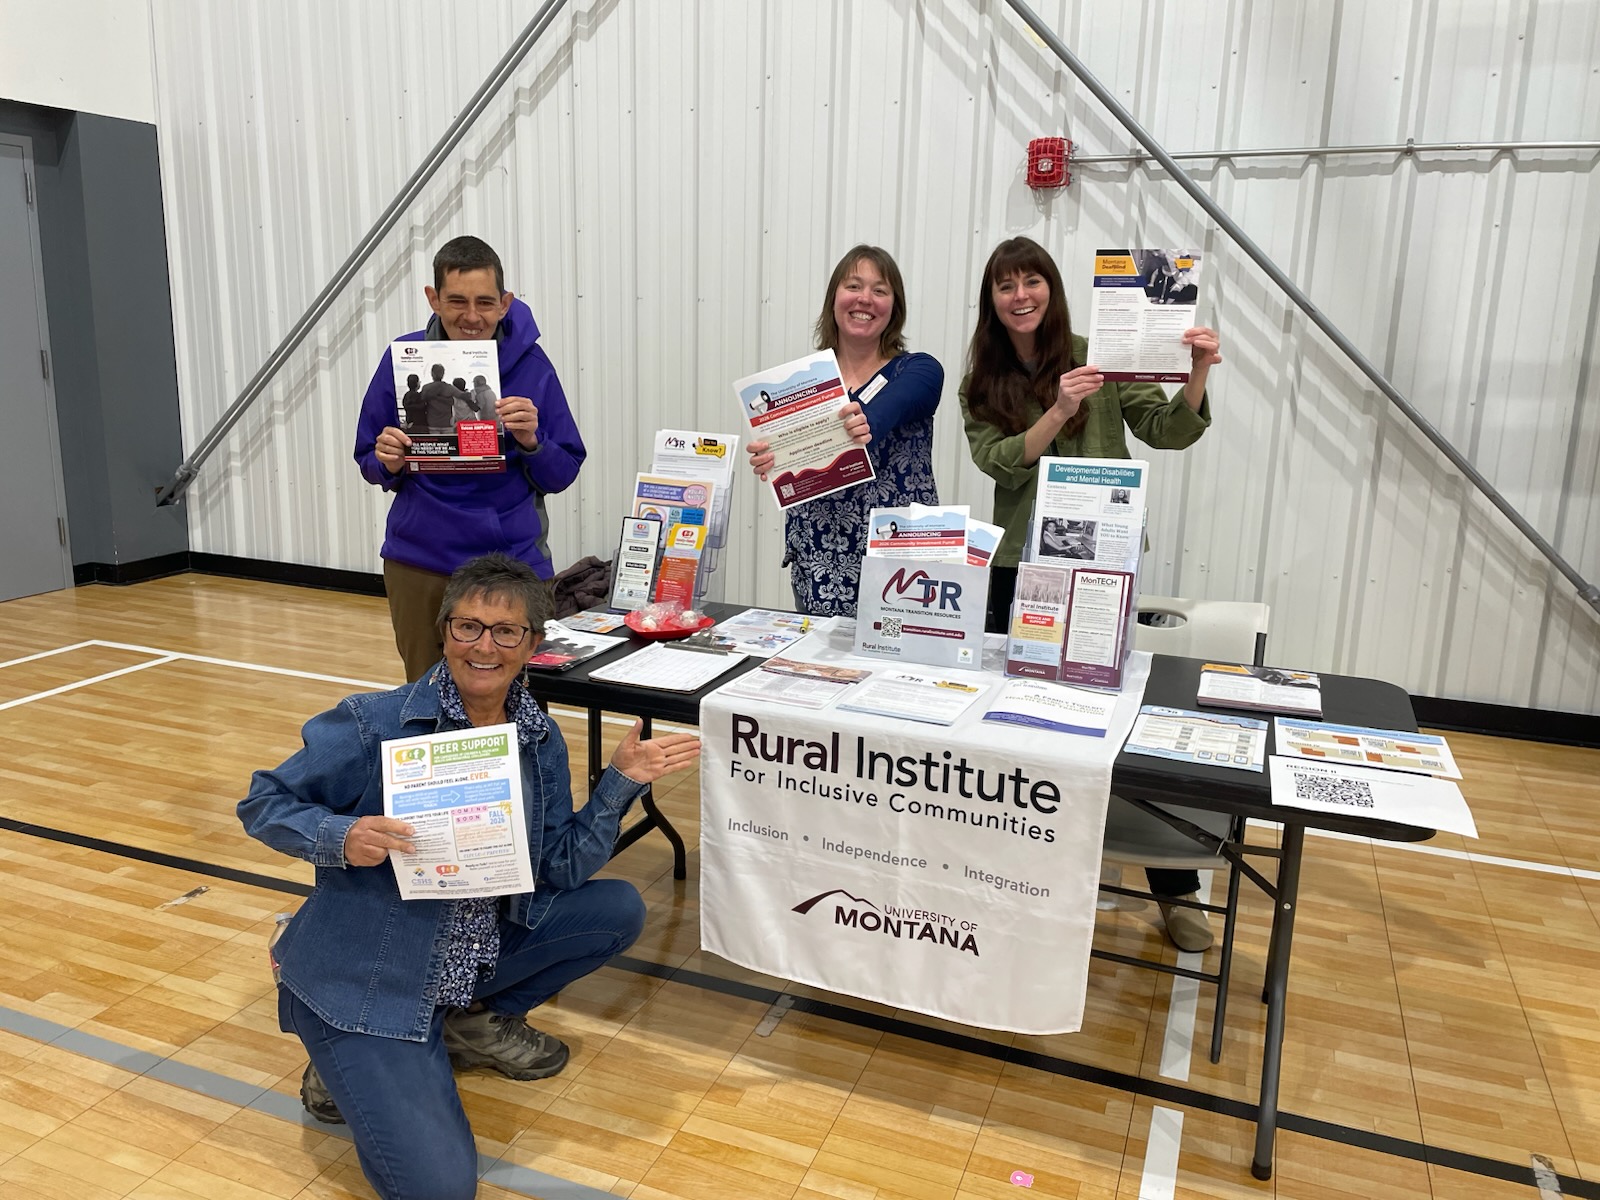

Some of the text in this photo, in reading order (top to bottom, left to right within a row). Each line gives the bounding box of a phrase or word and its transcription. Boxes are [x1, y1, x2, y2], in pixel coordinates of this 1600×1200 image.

[774, 387, 817, 407] ANNOUNCING
[778, 385, 796, 394] University
[769, 406, 795, 419] Community
[796, 398, 821, 409] Investment
[822, 392, 835, 400] Fund!
[793, 425, 809, 433] eligible
[815, 417, 830, 426] apply?
[789, 438, 832, 456] Application deadline
[1055, 465, 1135, 477] Developmental Disabilities
[882, 567, 962, 612] MTR
[1081, 576, 1117, 586] MonTECH
[877, 644, 901, 652] Institute
[433, 737, 505, 754] PEER SUPPORT
[732, 713, 839, 774] Rural
[856, 736, 1061, 814] Institute
[1286, 764, 1328, 773] REGION
[451, 806, 487, 815] COMING
[730, 761, 1056, 843] For Inclusive Communities
[489, 810, 504, 818] FALL
[490, 817, 505, 825] 2026
[727, 818, 1050, 898] Inclusion Independence Integration
[884, 904, 978, 933] UNIVERSITY OF
[834, 905, 980, 957] MONTANA
